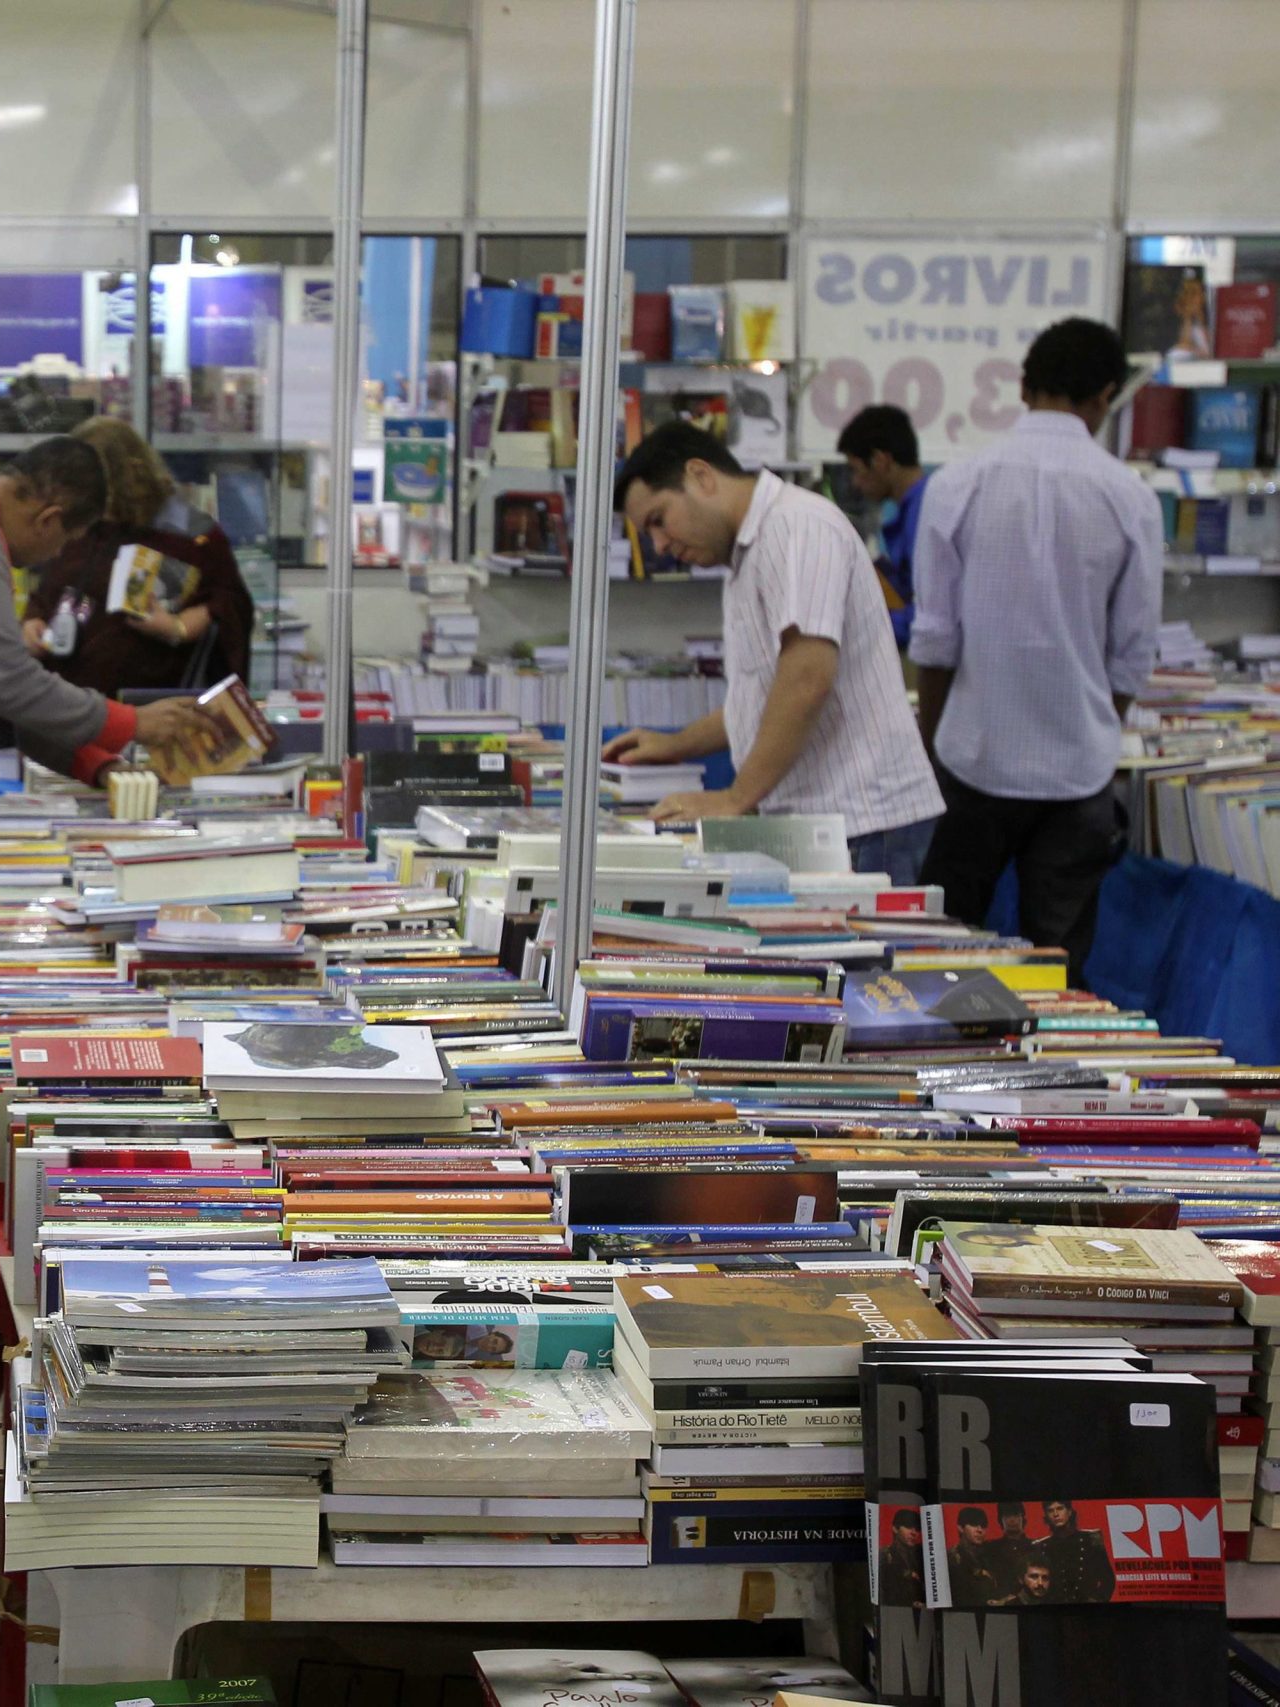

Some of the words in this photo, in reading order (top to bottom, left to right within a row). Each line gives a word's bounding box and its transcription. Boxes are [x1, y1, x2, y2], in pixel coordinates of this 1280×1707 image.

[734, 1164, 787, 1172] Making
[416, 1193, 491, 1201] REPUTAÇÃO
[430, 1243, 467, 1252] AGUDA
[467, 1243, 487, 1252] DOR
[1097, 1287, 1105, 1298] O
[1106, 1286, 1134, 1299] CÓDIGO
[1135, 1288, 1148, 1299] DA
[1148, 1288, 1170, 1300] VINCI
[408, 1314, 440, 1322] SABER
[442, 1314, 455, 1322] DE
[458, 1314, 487, 1322] MEDO
[489, 1314, 511, 1322] SEM
[692, 1358, 723, 1367] Pamuk
[725, 1358, 752, 1367] Orhan
[755, 1358, 790, 1368] Istambul
[758, 1397, 777, 1405] russo
[777, 1397, 806, 1405] romance
[806, 1397, 819, 1406] Um
[672, 1413, 718, 1428] História
[718, 1413, 735, 1427] do
[736, 1413, 757, 1427] Rio
[757, 1413, 788, 1427] Tietê
[804, 1414, 841, 1426] MELLO
[691, 1432, 718, 1440] MEYER
[727, 1431, 758, 1439] VICTOR
[877, 1383, 927, 1480] R
[938, 1394, 993, 1492] R
[925, 1511, 934, 1540] MINUTO
[732, 1528, 800, 1543] HISTÓRIA
[803, 1528, 824, 1540] NA
[1106, 1504, 1222, 1559] RPM
[927, 1540, 935, 1557] POR
[942, 1611, 1021, 1707] M
[218, 1679, 257, 1688] 2007
[541, 1688, 639, 1704] Paulo
